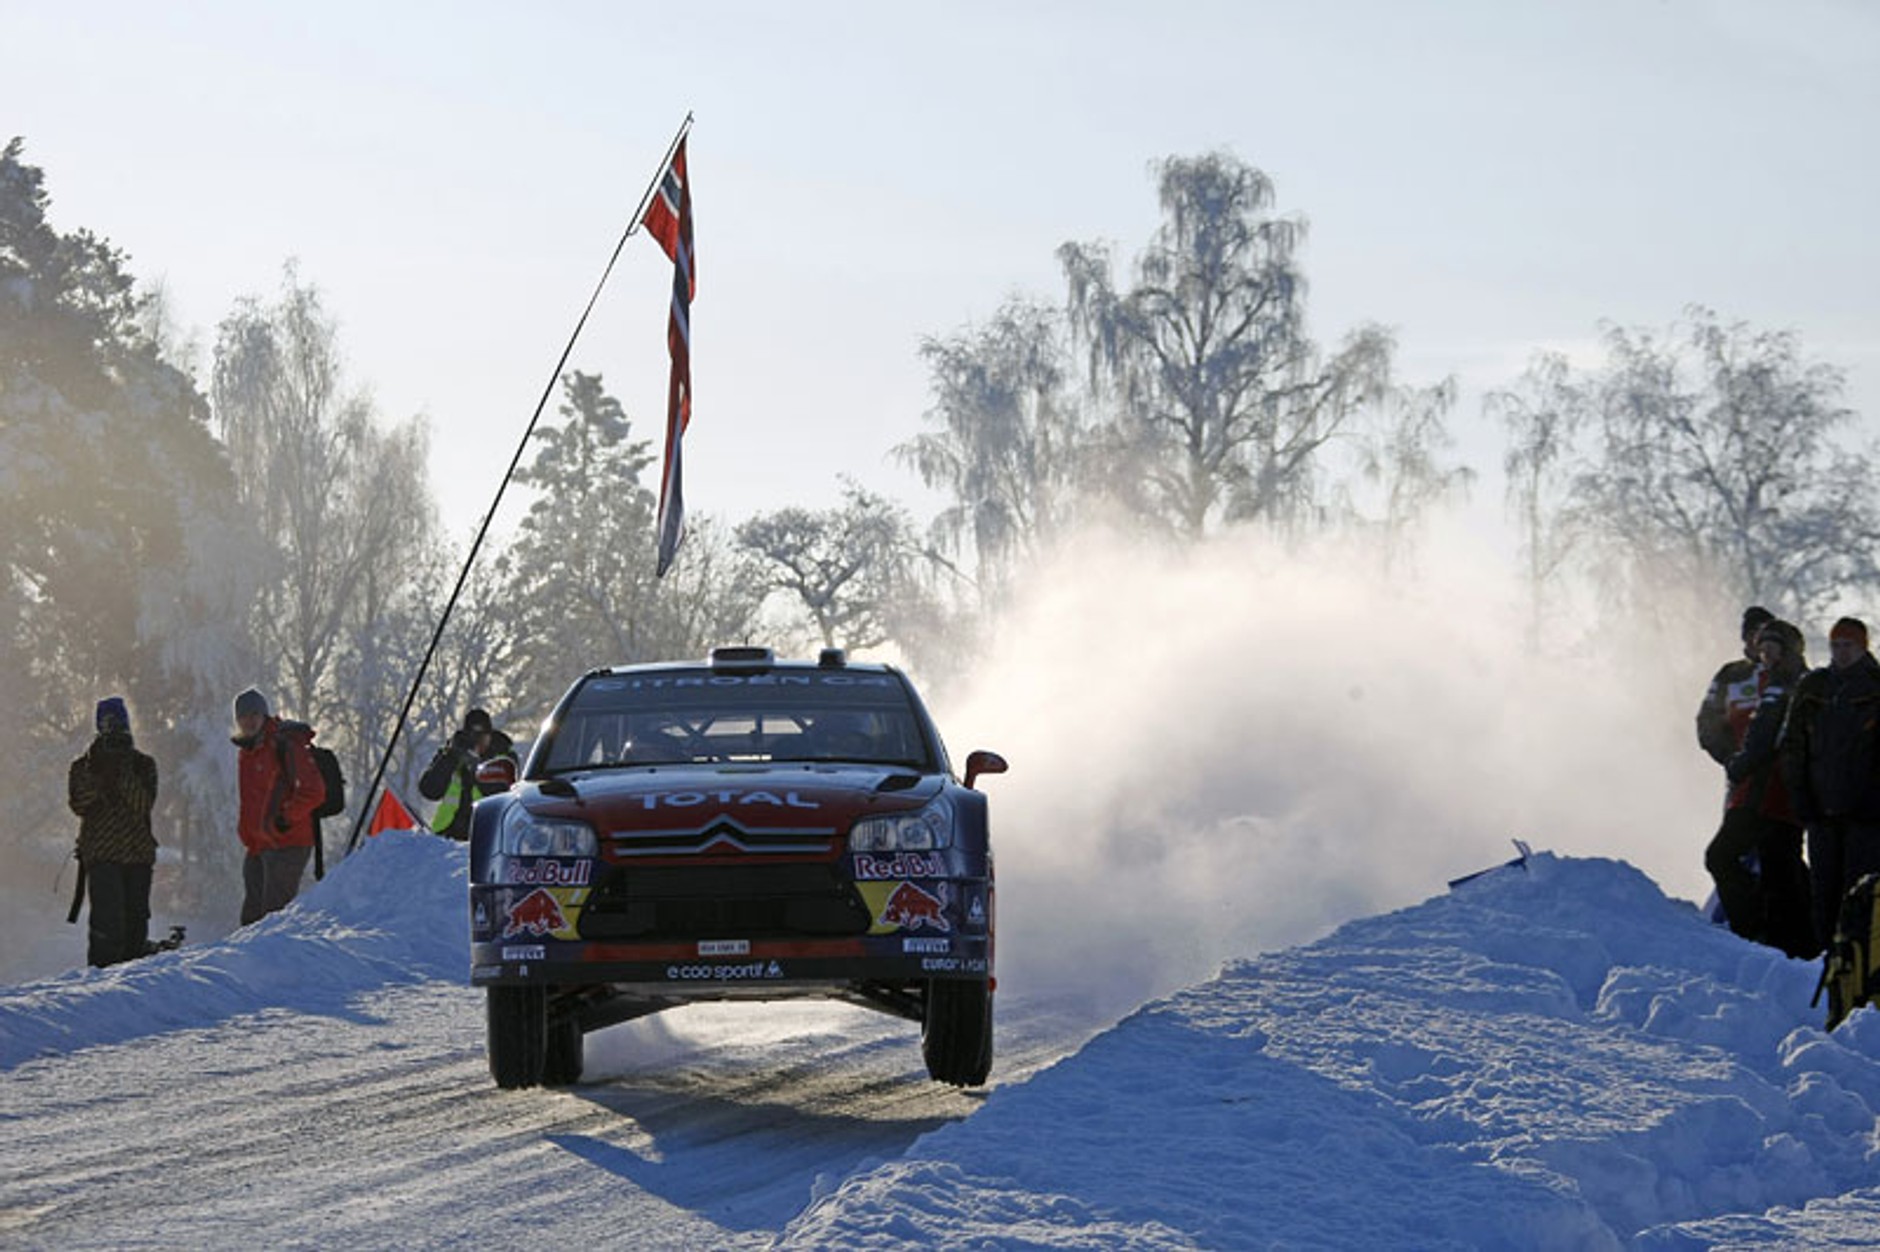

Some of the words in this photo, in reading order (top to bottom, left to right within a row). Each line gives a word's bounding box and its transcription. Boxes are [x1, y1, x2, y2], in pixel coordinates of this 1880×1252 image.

[636, 789, 820, 810] TOTAL
[541, 860, 592, 886] Bull
[854, 853, 906, 879] Red
[714, 961, 763, 982] sportif
